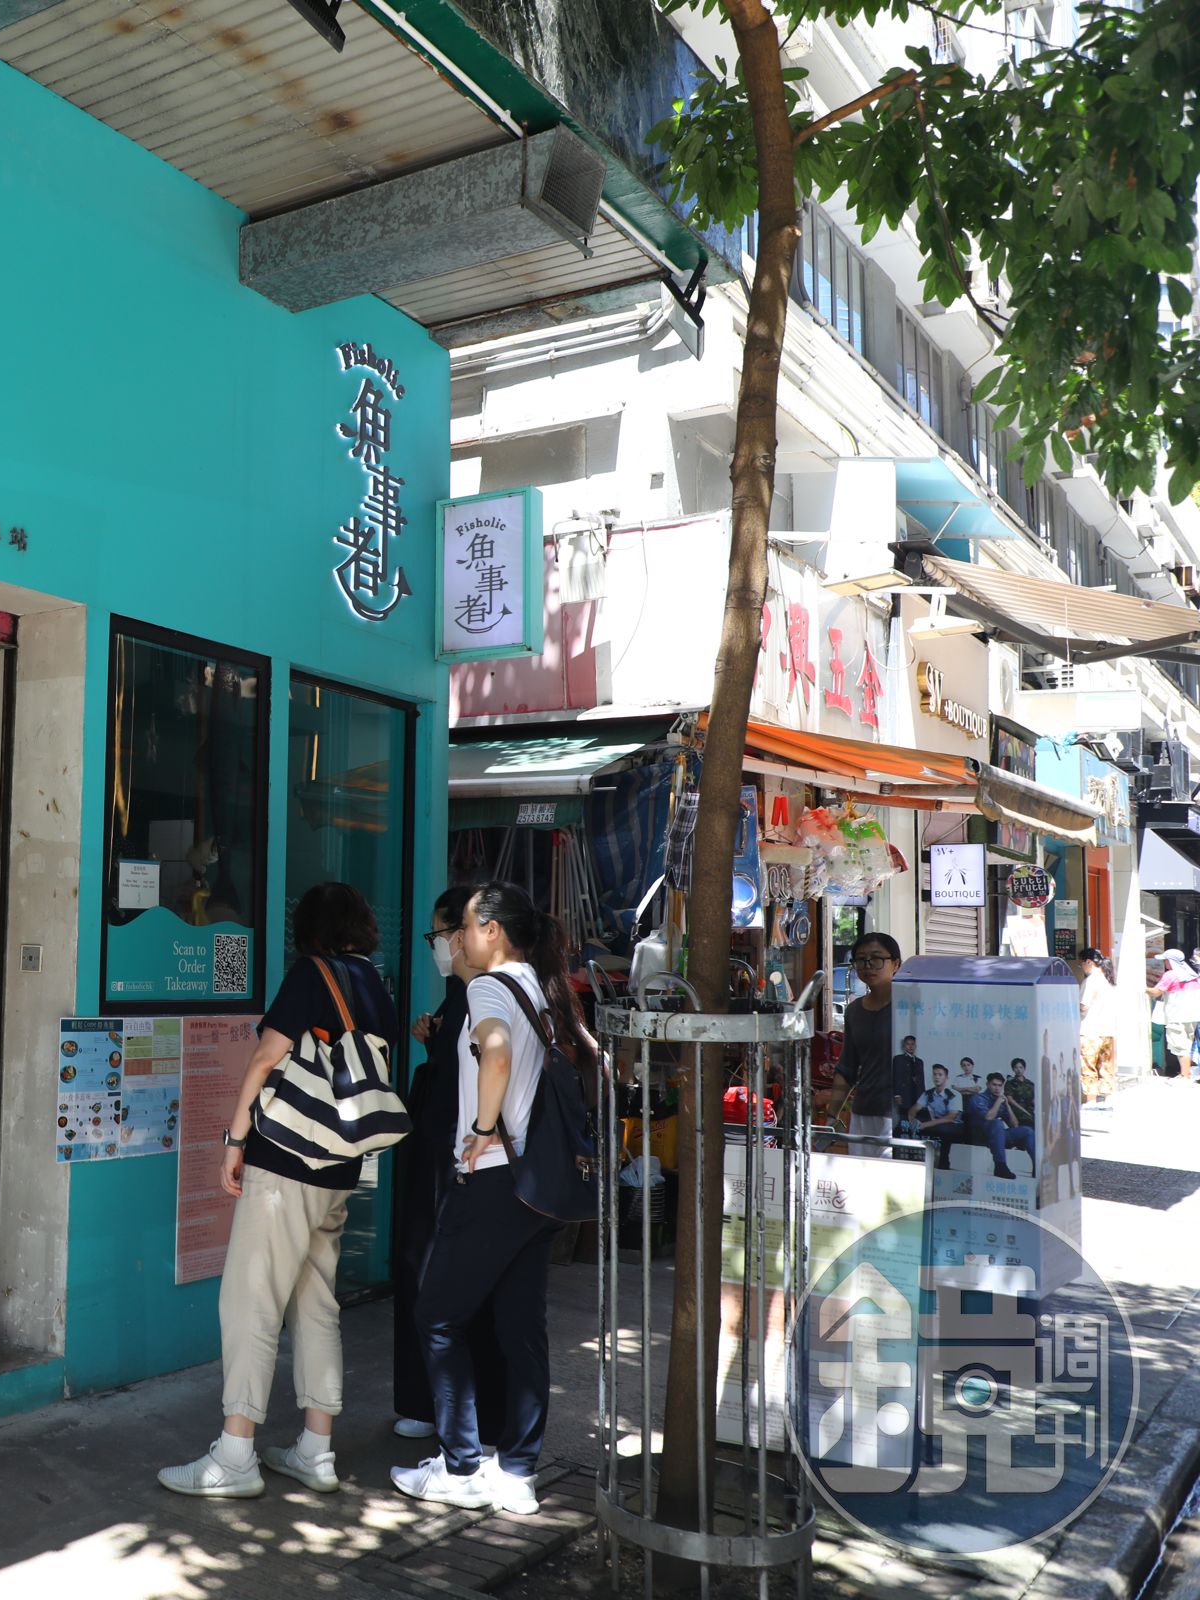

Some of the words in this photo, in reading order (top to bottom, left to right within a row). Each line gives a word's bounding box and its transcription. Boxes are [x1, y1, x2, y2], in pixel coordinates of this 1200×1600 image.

[337, 343, 406, 400] Fisholic
[455, 517, 507, 538] Fisholic
[934, 890, 981, 898] BOUTIQUE
[173, 940, 194, 956] Scan
[196, 943, 207, 956] to
[178, 958, 206, 973] Order
[164, 976, 209, 995] Takeaway
